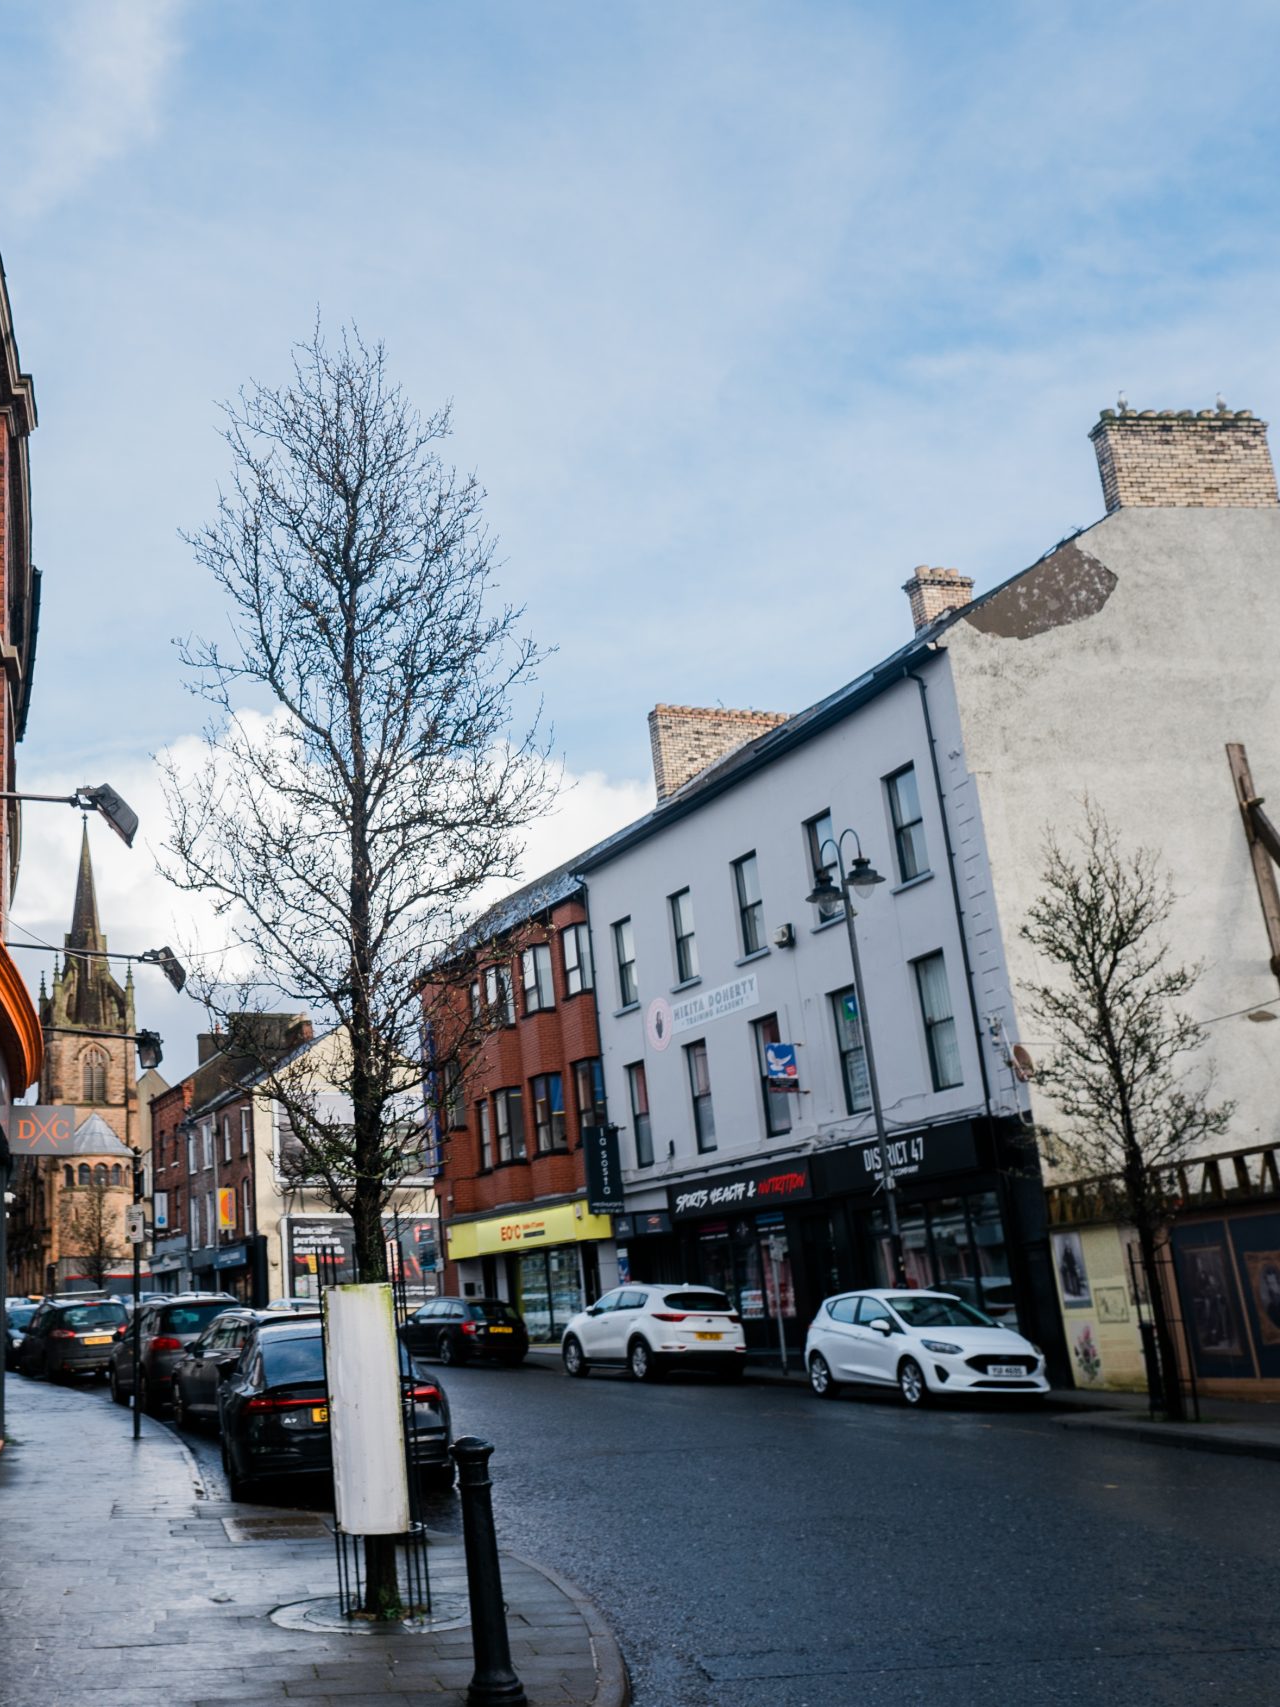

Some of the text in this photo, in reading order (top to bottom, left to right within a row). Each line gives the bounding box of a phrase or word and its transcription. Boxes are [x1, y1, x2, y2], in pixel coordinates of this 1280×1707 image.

[708, 978, 755, 1008] DOHERTY
[16, 1111, 70, 1149] DXC
[863, 1136, 924, 1172] DISRICT 47
[675, 1189, 709, 1214] SPORTS
